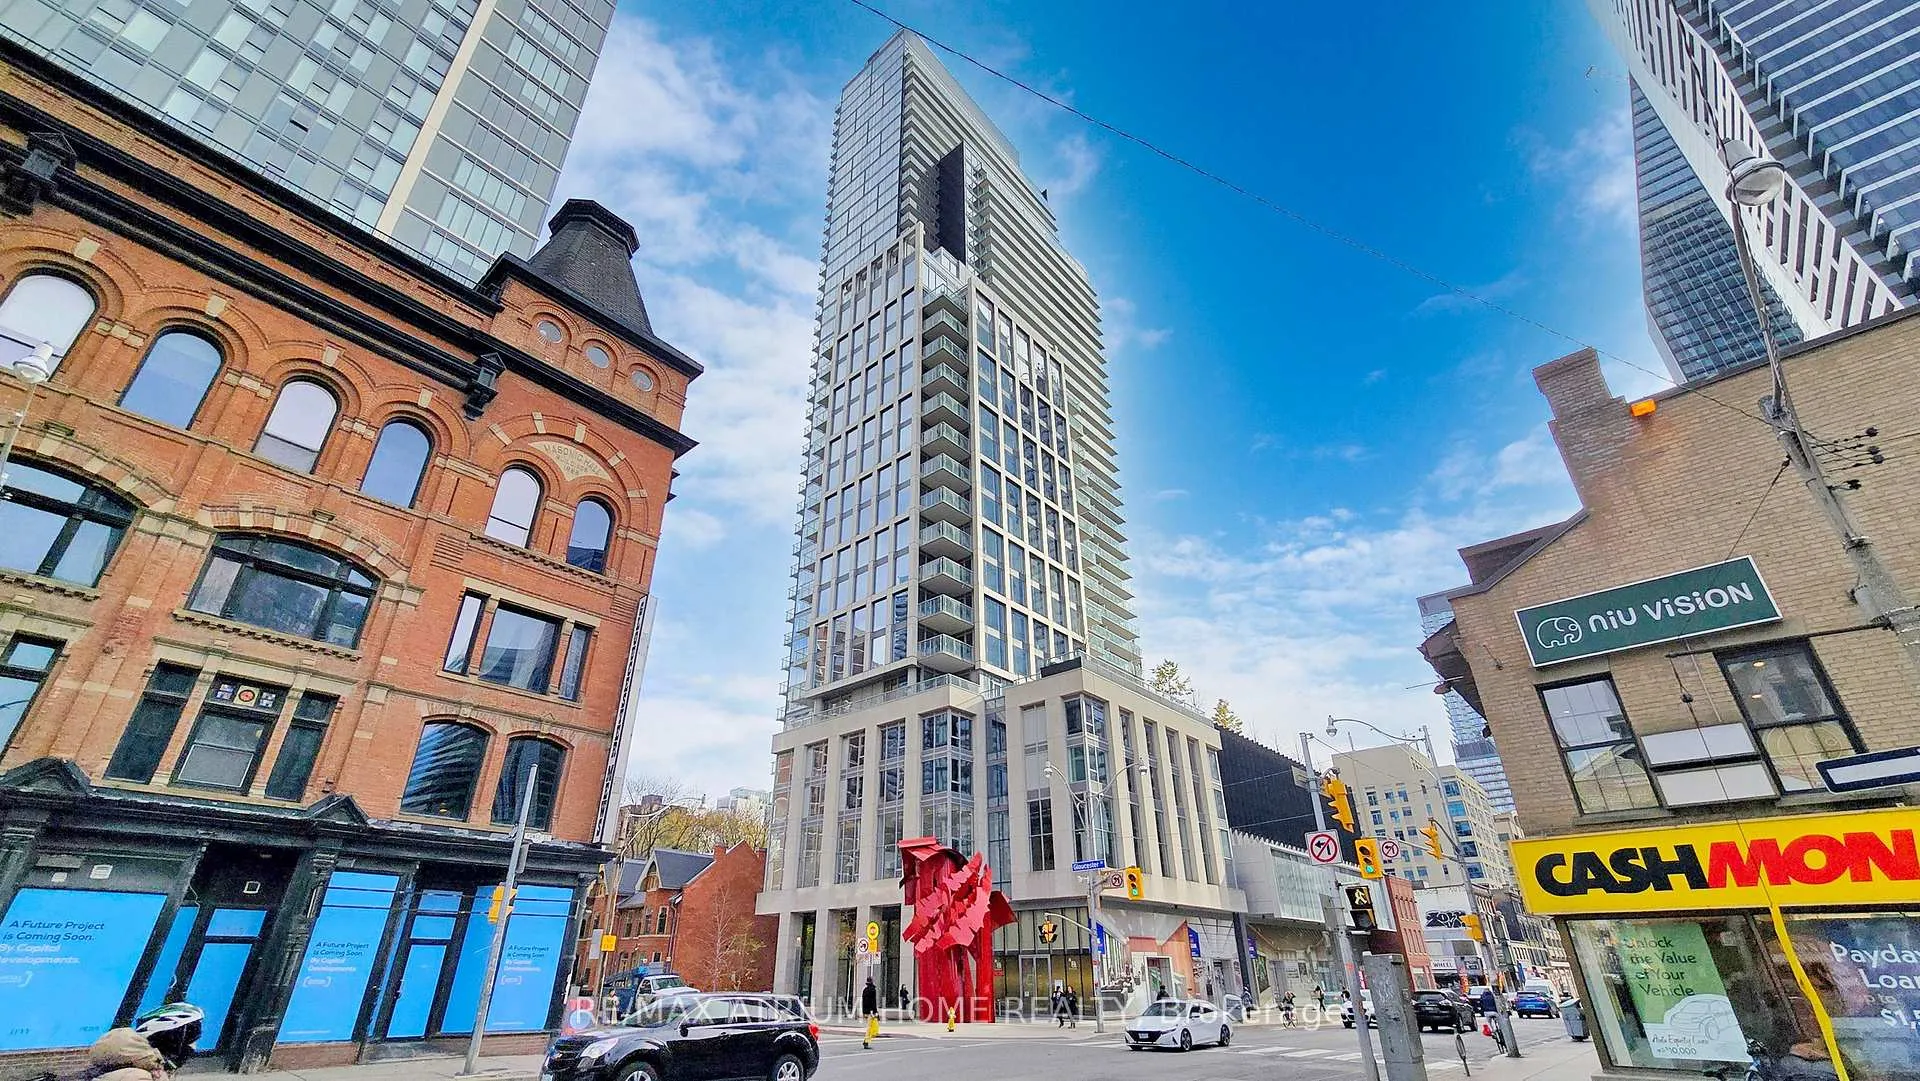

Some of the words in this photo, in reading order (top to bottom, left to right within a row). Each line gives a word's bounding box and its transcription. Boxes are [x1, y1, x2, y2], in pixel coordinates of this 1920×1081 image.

[544, 444, 584, 462] MASONIC
[1073, 861, 1100, 870] Gloucester
[1534, 844, 1710, 896] CASH
[9, 921, 20, 929] A
[22, 921, 63, 929] Future
[64, 922, 105, 930] Project
[16, 932, 62, 943] Coming
[17, 944, 61, 953] Capital
[0, 957, 80, 965] evelopments.
[1655, 952, 1697, 964] Value
[1650, 968, 1685, 980] Your
[1639, 984, 1696, 997] Vehicle
